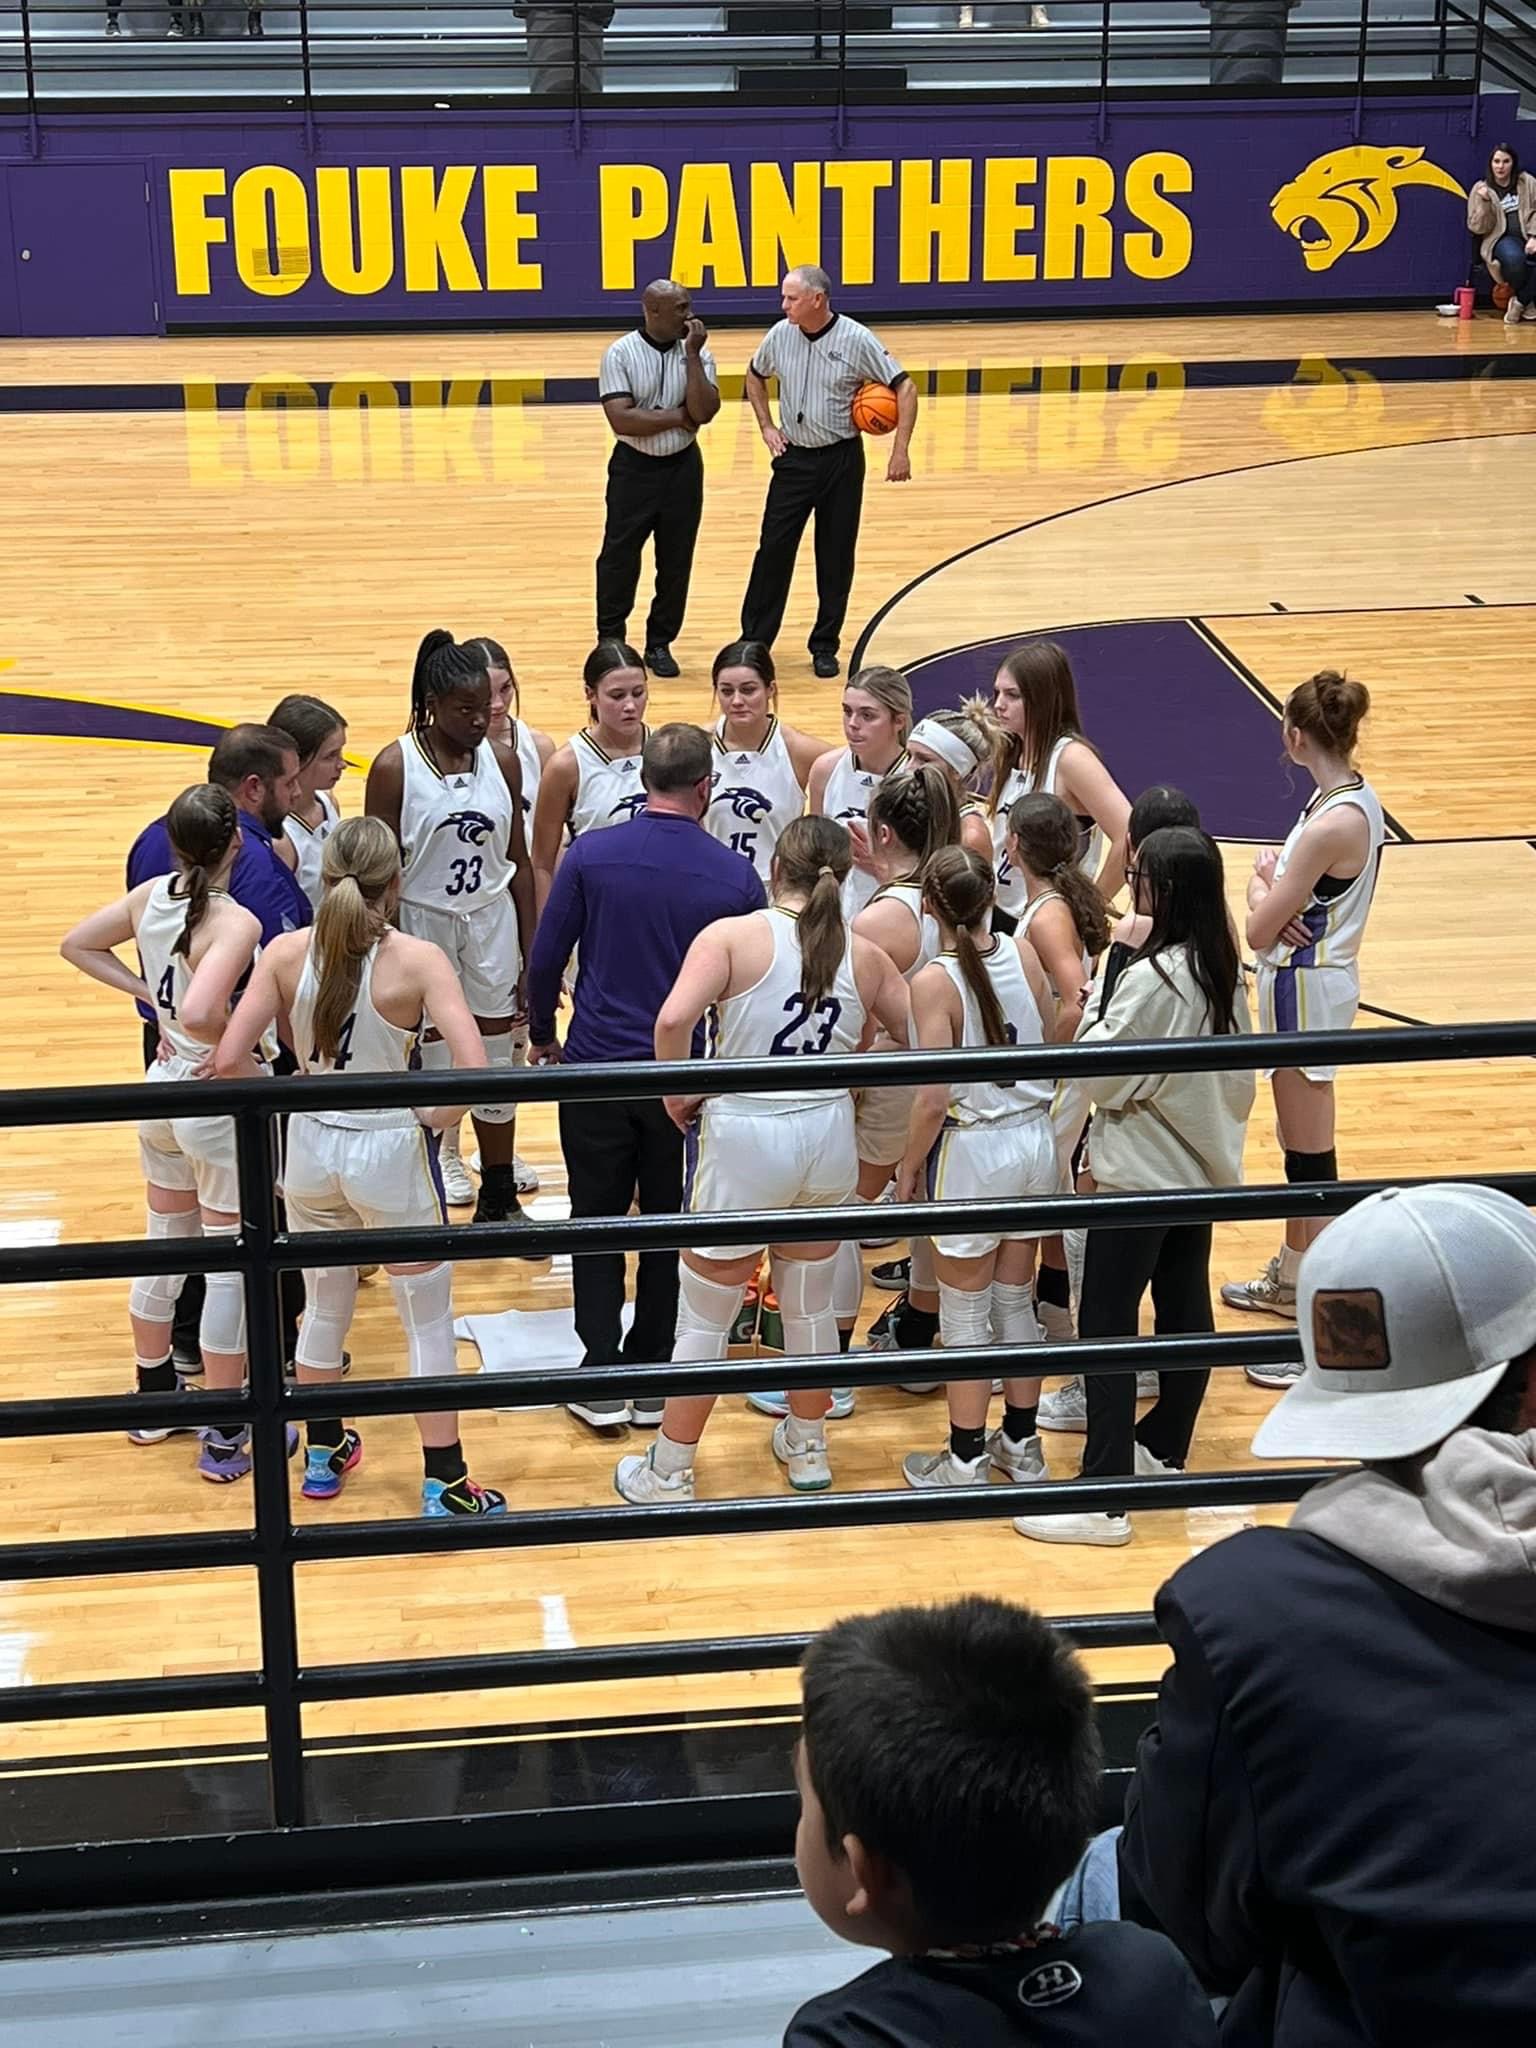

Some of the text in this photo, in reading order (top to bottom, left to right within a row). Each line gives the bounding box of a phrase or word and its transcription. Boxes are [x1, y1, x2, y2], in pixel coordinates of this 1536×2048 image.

[168, 151, 1193, 297] FOUKE PANTHERS
[730, 832, 757, 863] 15
[445, 855, 483, 896] 33
[157, 965, 177, 1020] 4
[769, 992, 841, 1056] 23
